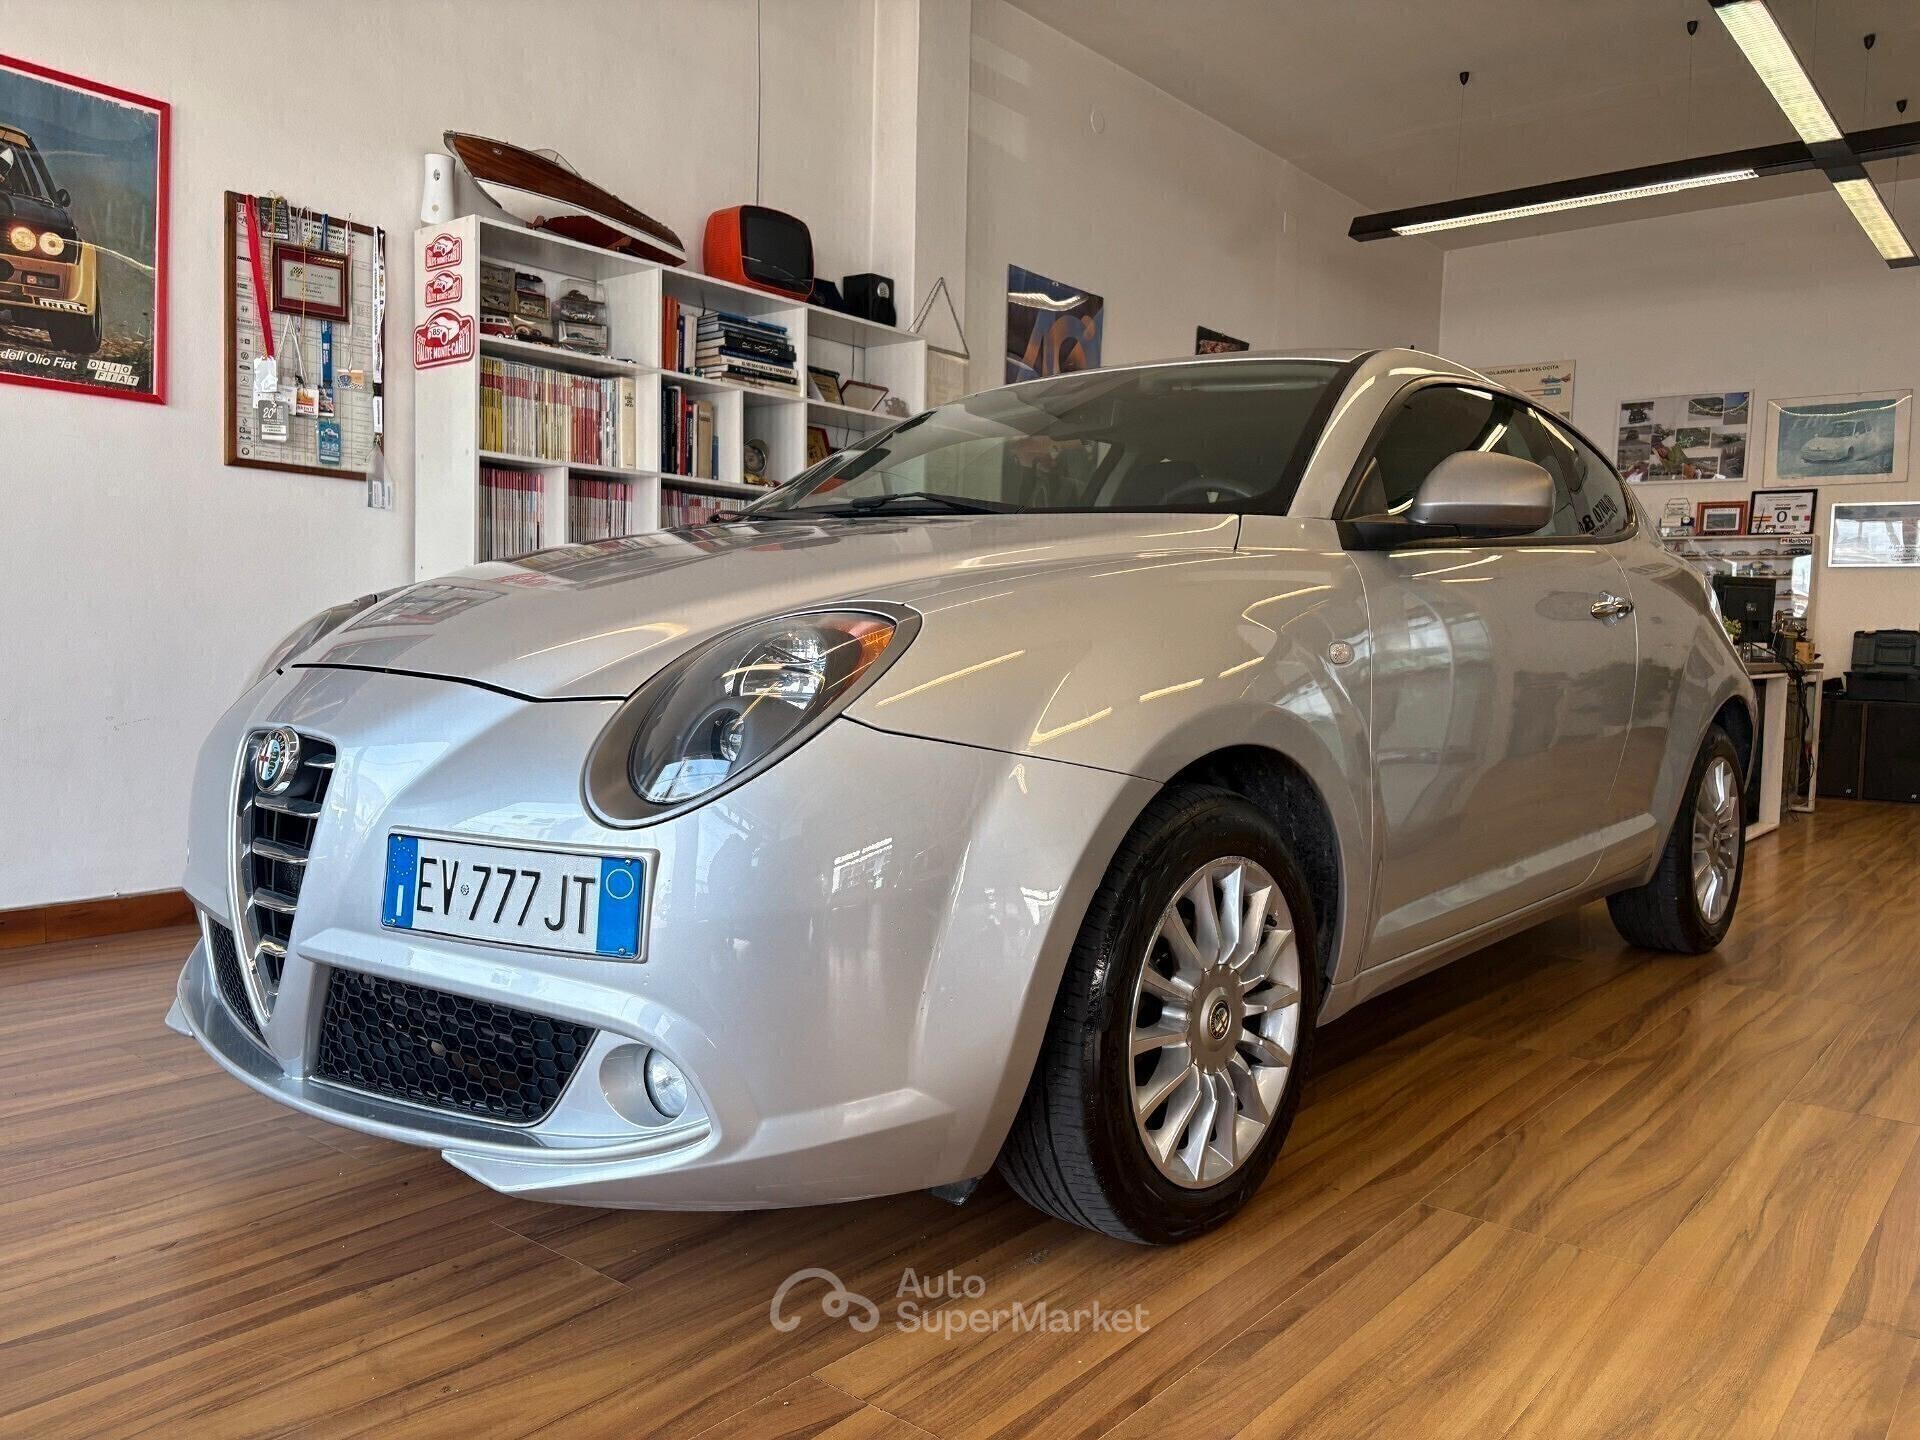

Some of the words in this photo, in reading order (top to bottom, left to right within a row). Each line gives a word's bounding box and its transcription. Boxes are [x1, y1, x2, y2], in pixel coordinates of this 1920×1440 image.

[1, 348, 51, 366] dell'Olio
[53, 356, 78, 371] Fiat
[88, 360, 131, 374] OLIO
[97, 371, 139, 385] FIAT
